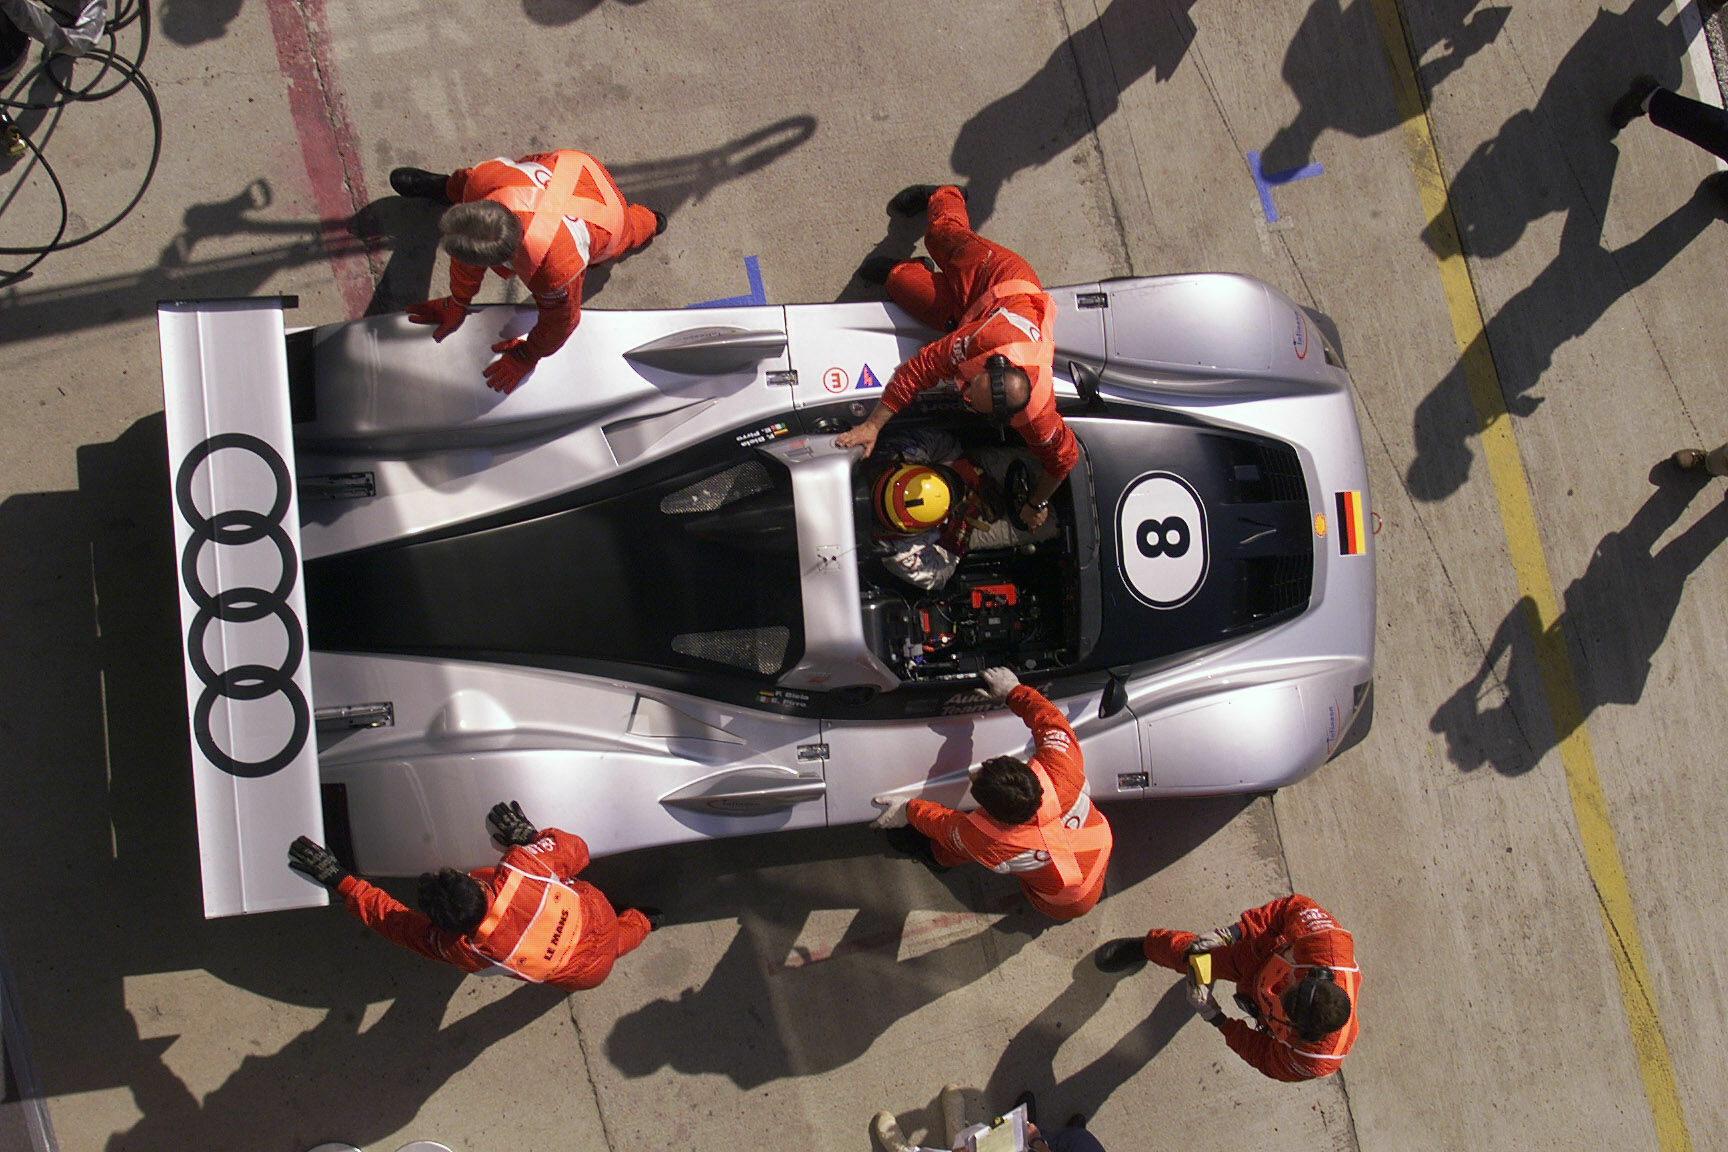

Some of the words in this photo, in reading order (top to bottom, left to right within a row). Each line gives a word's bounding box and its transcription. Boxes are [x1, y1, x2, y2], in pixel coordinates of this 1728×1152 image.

[831, 372, 842, 389] E
[1136, 516, 1190, 558] 8
[544, 947, 556, 960] LE
[550, 909, 569, 946] MANS
